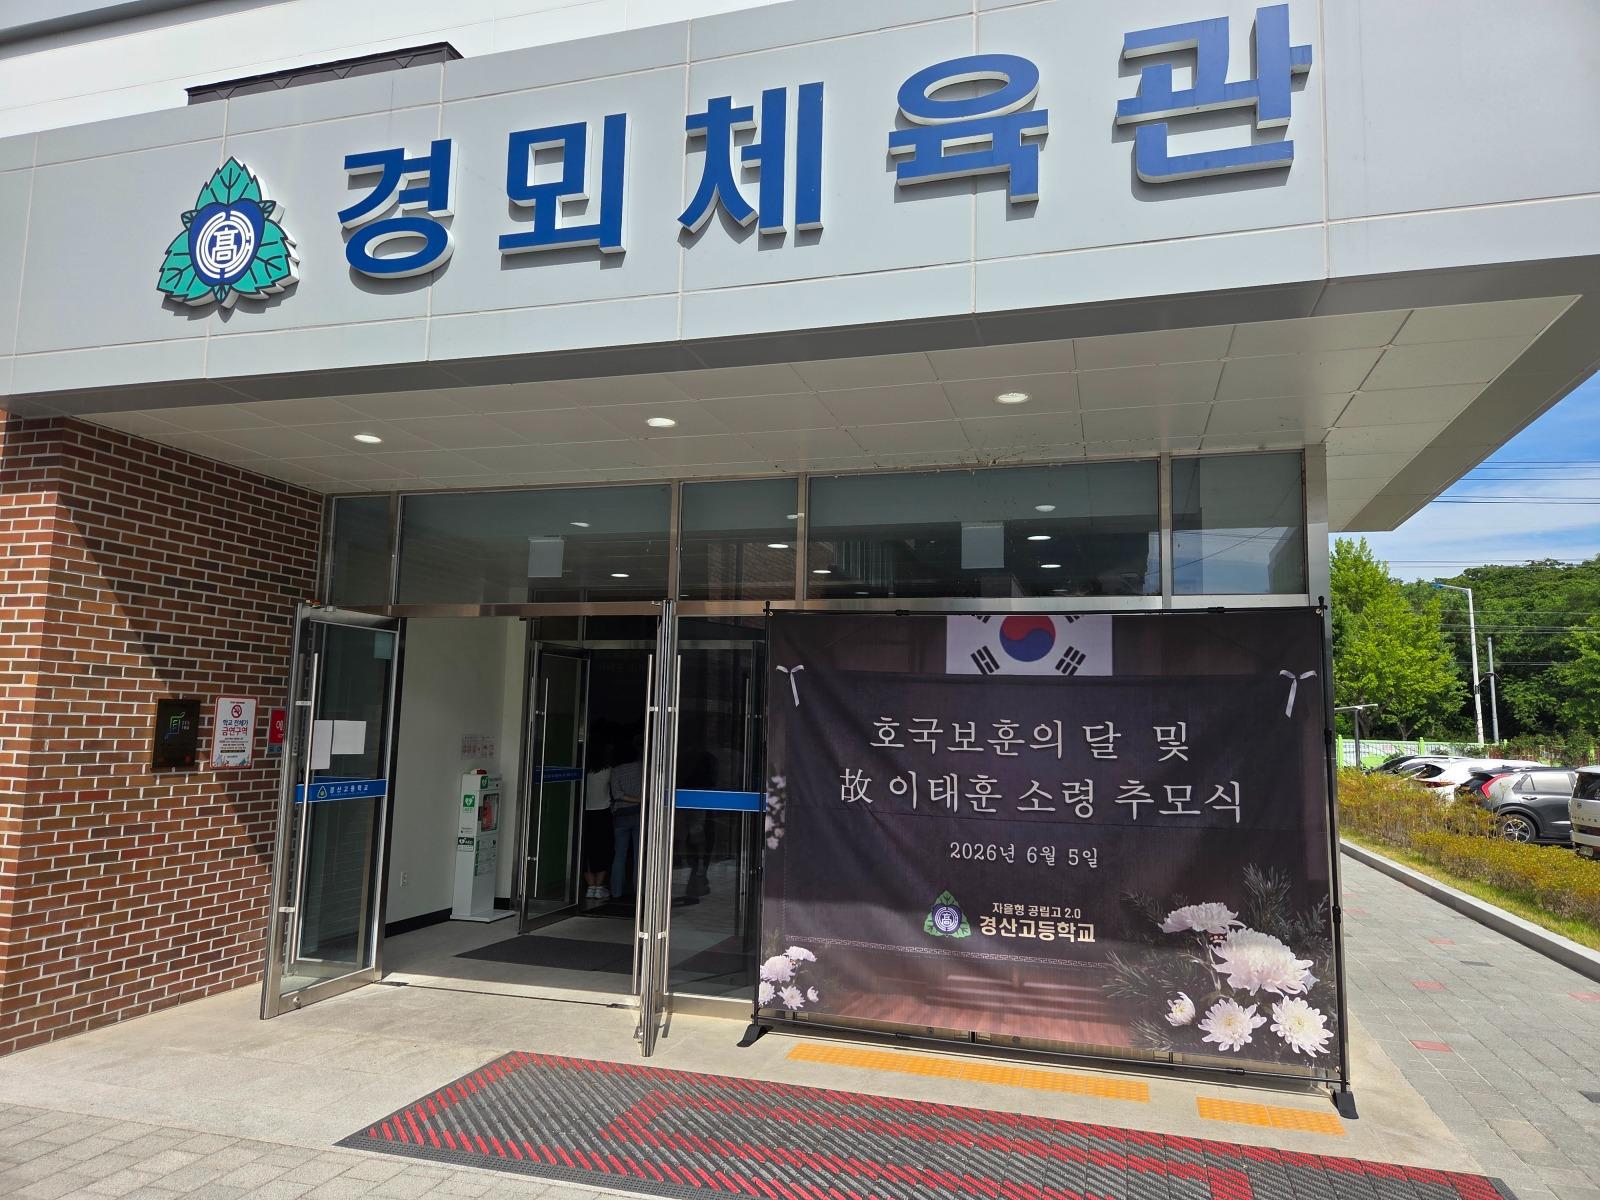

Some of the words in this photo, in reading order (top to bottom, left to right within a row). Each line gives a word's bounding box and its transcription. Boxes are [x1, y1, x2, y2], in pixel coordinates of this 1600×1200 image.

[337, 4, 1312, 278] 경뫼체육관
[221, 726, 248, 737] 금연구역
[222, 719, 233, 727] 학교
[870, 716, 1062, 760] 호국보훈의
[1082, 721, 1122, 759] 달
[1152, 721, 1189, 762] 및
[839, 768, 873, 804] 故
[889, 770, 1003, 813] 이태훈
[1016, 778, 1095, 819] 소령
[1114, 779, 1241, 824] 추모식
[949, 841, 1015, 864] 2026년
[1026, 845, 1056, 867] 6월
[1068, 848, 1098, 869] 5일
[1028, 904, 1062, 918] 공립고
[1064, 907, 1082, 919] 2.0
[979, 915, 1096, 943] 경산고등학교
